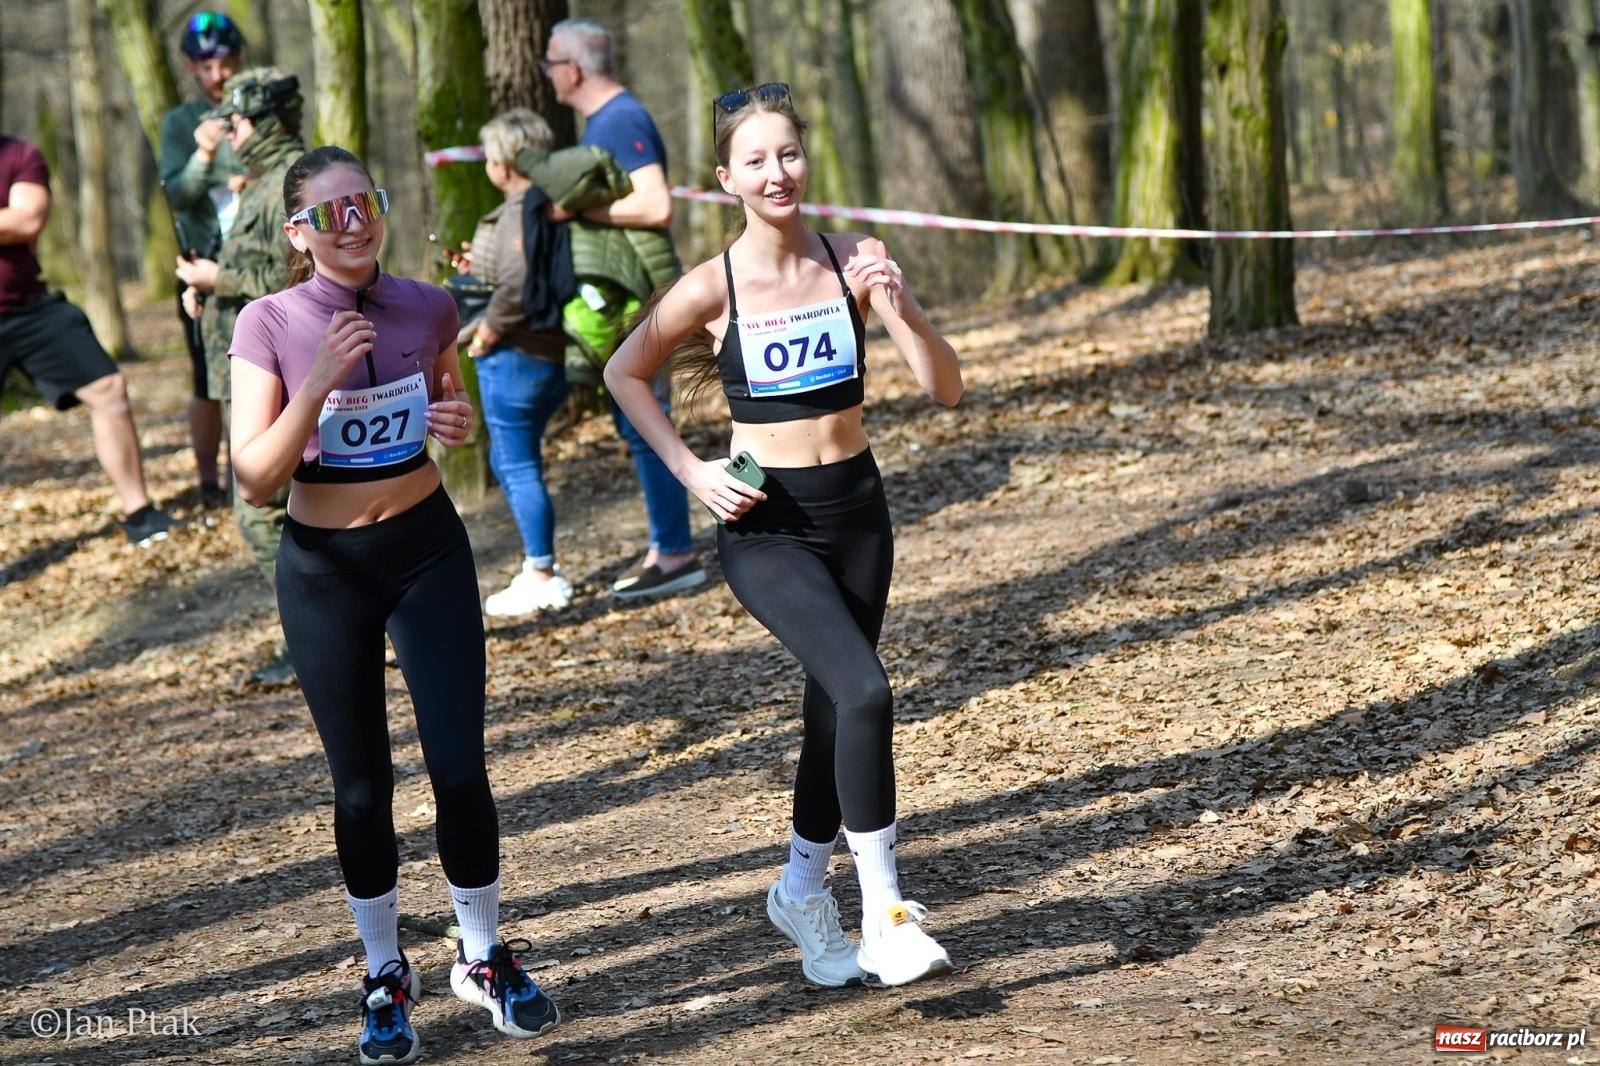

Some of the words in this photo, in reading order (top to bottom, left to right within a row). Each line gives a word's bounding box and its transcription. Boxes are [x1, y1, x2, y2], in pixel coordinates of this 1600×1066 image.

[764, 332, 837, 372] 074
[326, 397, 343, 405] XIV
[346, 395, 368, 405] BIEG
[371, 382, 419, 402] TWARDZIELA
[341, 408, 410, 448] 027
